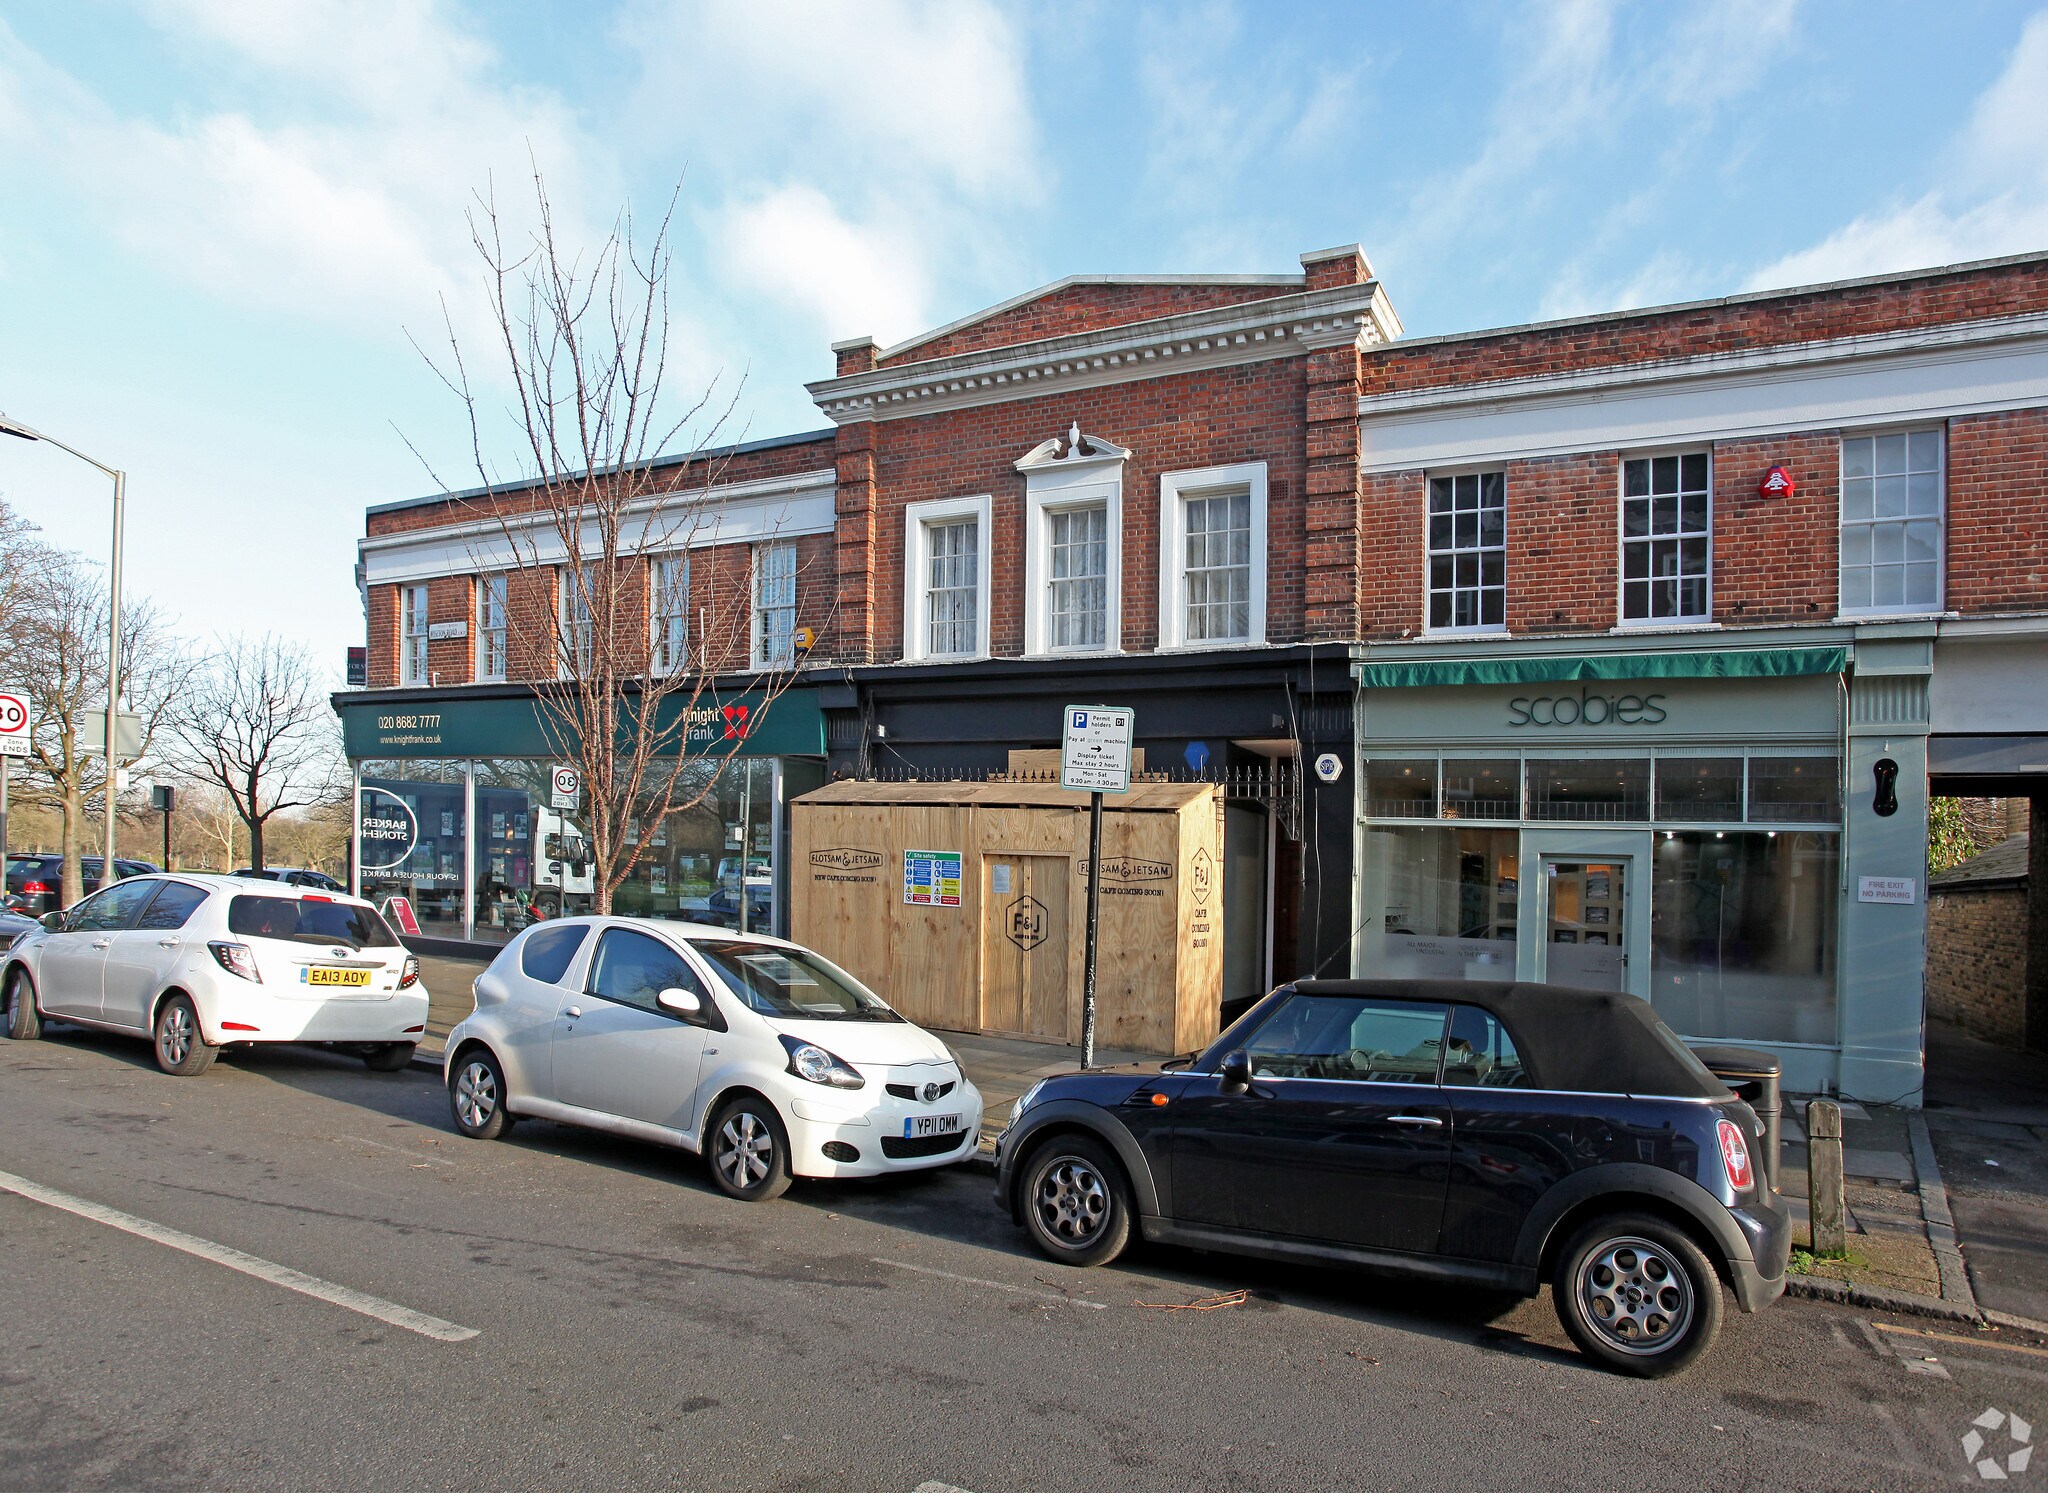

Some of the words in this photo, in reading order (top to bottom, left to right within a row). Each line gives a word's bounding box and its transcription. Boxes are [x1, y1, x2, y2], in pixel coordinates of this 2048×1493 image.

[1508, 686, 1667, 726] scobies
[378, 716, 394, 729] 020
[396, 715, 418, 729] 8682
[419, 714, 441, 728] 7777
[685, 725, 715, 740] rank
[380, 734, 442, 746] www.knightfrank.co.uk
[3, 745, 28, 753] ENDS
[1077, 752, 1097, 760] Display
[811, 854, 841, 863] FLOTSAM
[842, 852, 850, 867] &
[851, 855, 880, 864] JETSAM
[1081, 863, 1120, 874] FLSAM
[1120, 861, 1131, 878] &
[1132, 865, 1168, 875] JETSAM
[1117, 887, 1144, 896] COMING
[1868, 881, 1885, 889] FIRE
[1887, 881, 1905, 889] EXIT
[1876, 891, 1911, 899] PARKING
[312, 970, 340, 982] EA13
[343, 971, 367, 983] AOY
[917, 1118, 937, 1135] YP11
[939, 1116, 958, 1132] OMM
